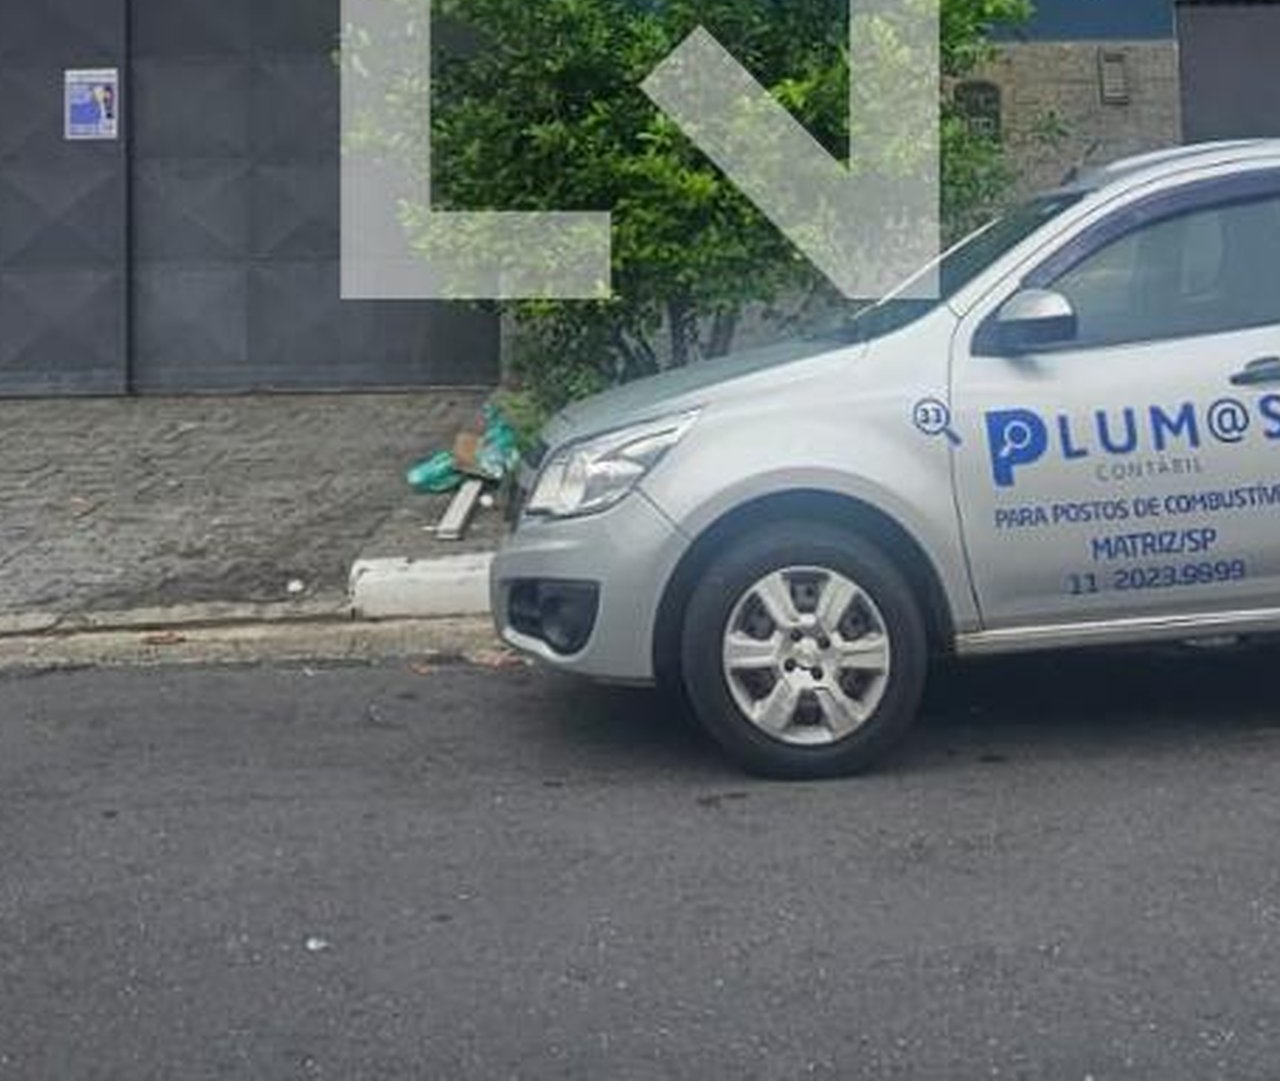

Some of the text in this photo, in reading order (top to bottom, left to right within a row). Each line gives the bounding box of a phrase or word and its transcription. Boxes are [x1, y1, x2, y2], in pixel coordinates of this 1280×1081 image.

[995, 506, 1048, 528] PARA
[1052, 499, 1129, 523] POSTOS
[1133, 496, 1161, 518] DE
[1092, 527, 1217, 560] MATRIZ/SP
[1066, 572, 1098, 595] 11
